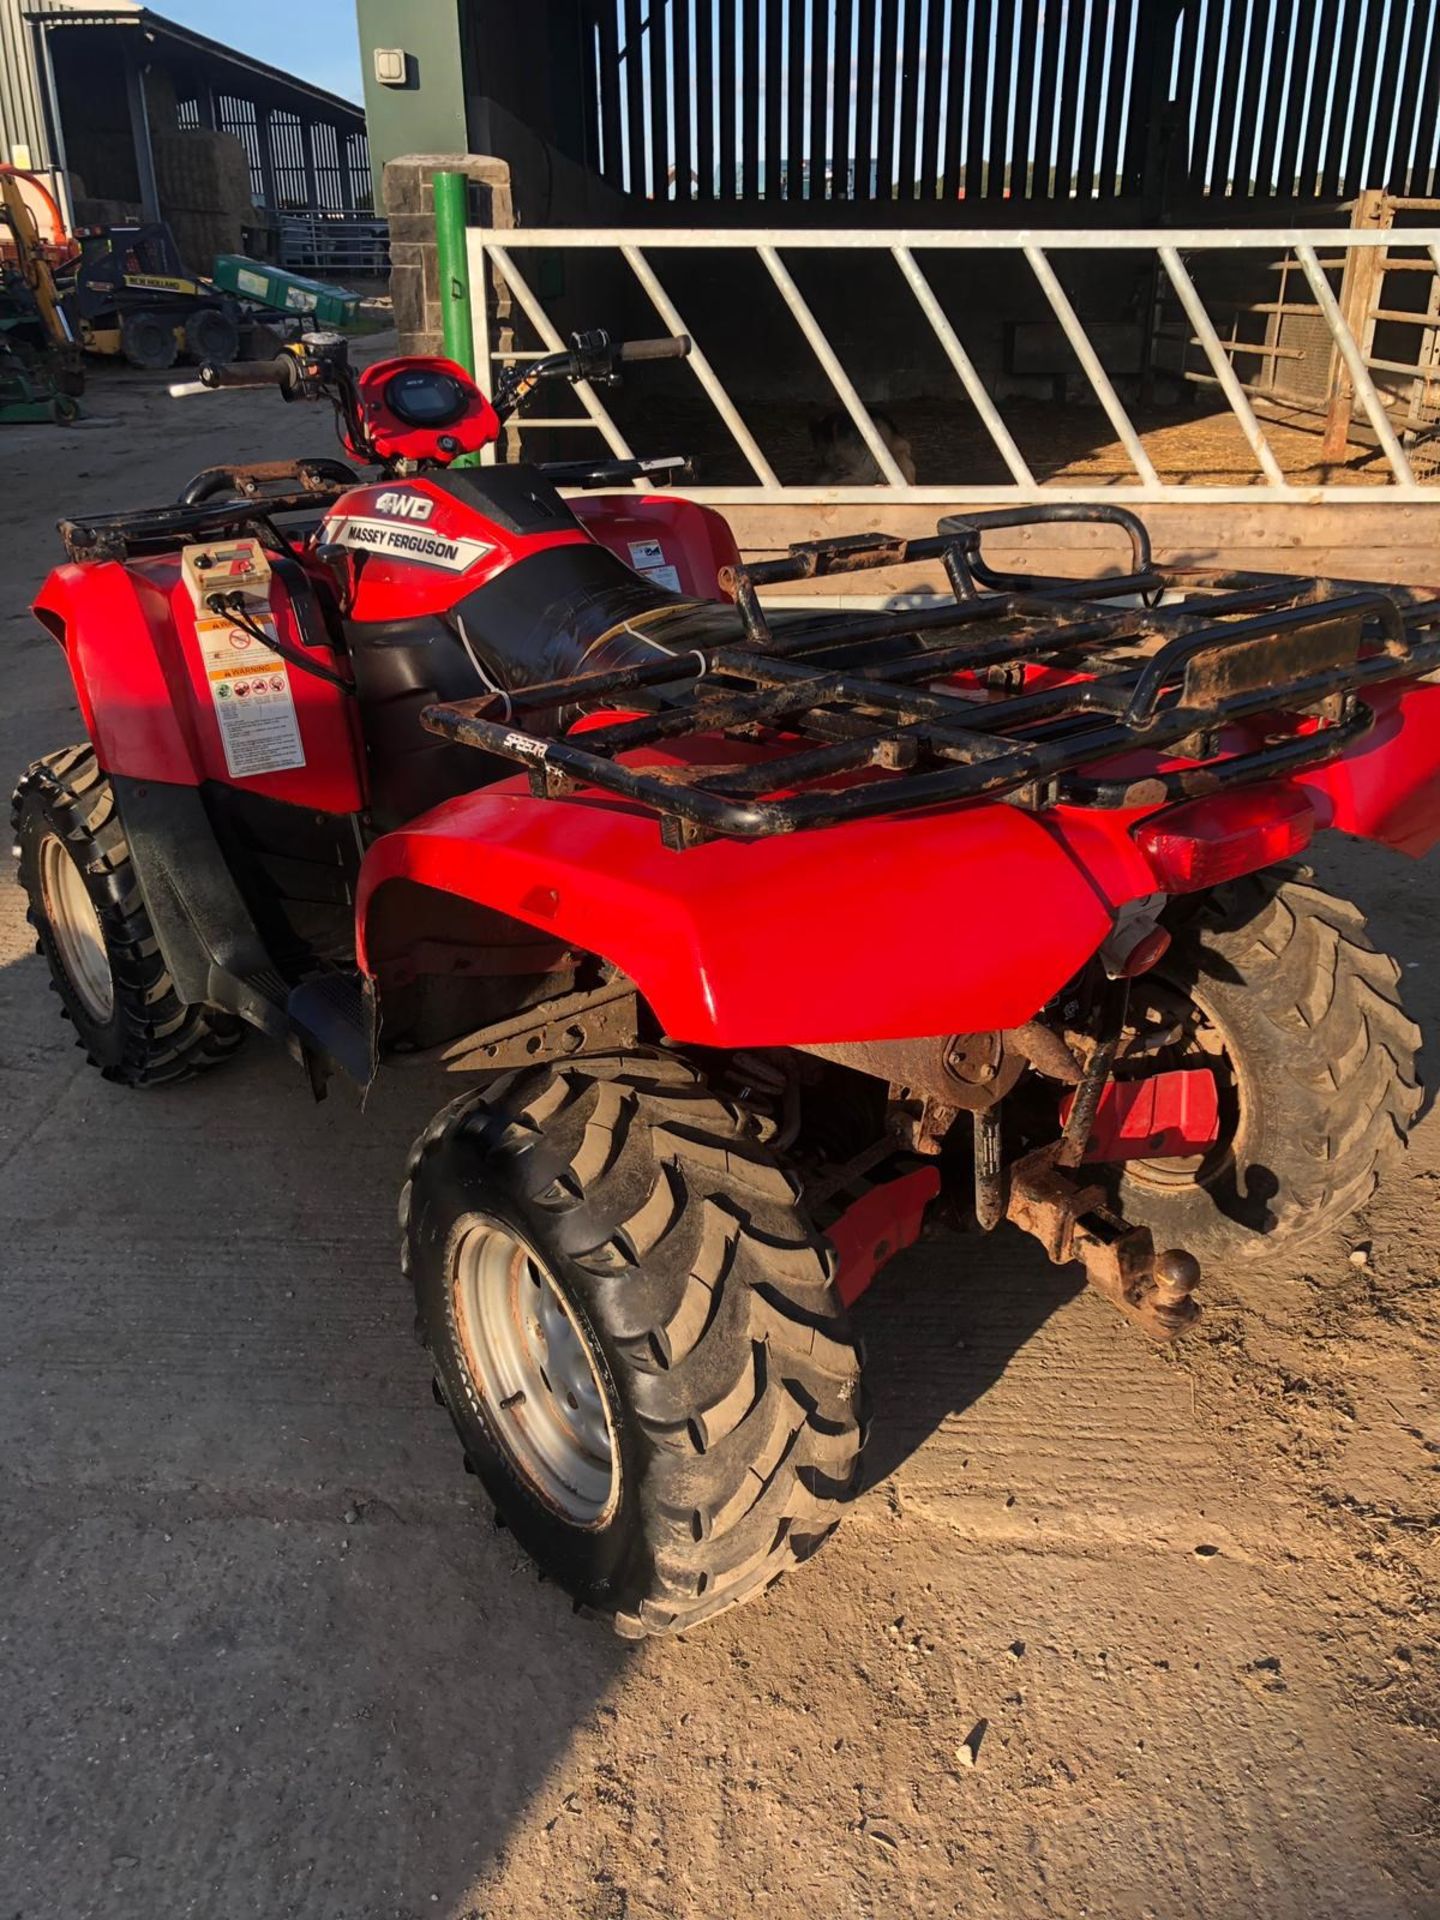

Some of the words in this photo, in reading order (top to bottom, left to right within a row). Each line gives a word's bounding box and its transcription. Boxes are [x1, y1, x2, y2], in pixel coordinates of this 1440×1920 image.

[147, 279, 179, 289] HOLLAND
[375, 492, 434, 520] 4WD
[348, 526, 387, 544] MASSEY
[388, 533, 459, 560] FERGUSON
[231, 664, 272, 677] WARNING
